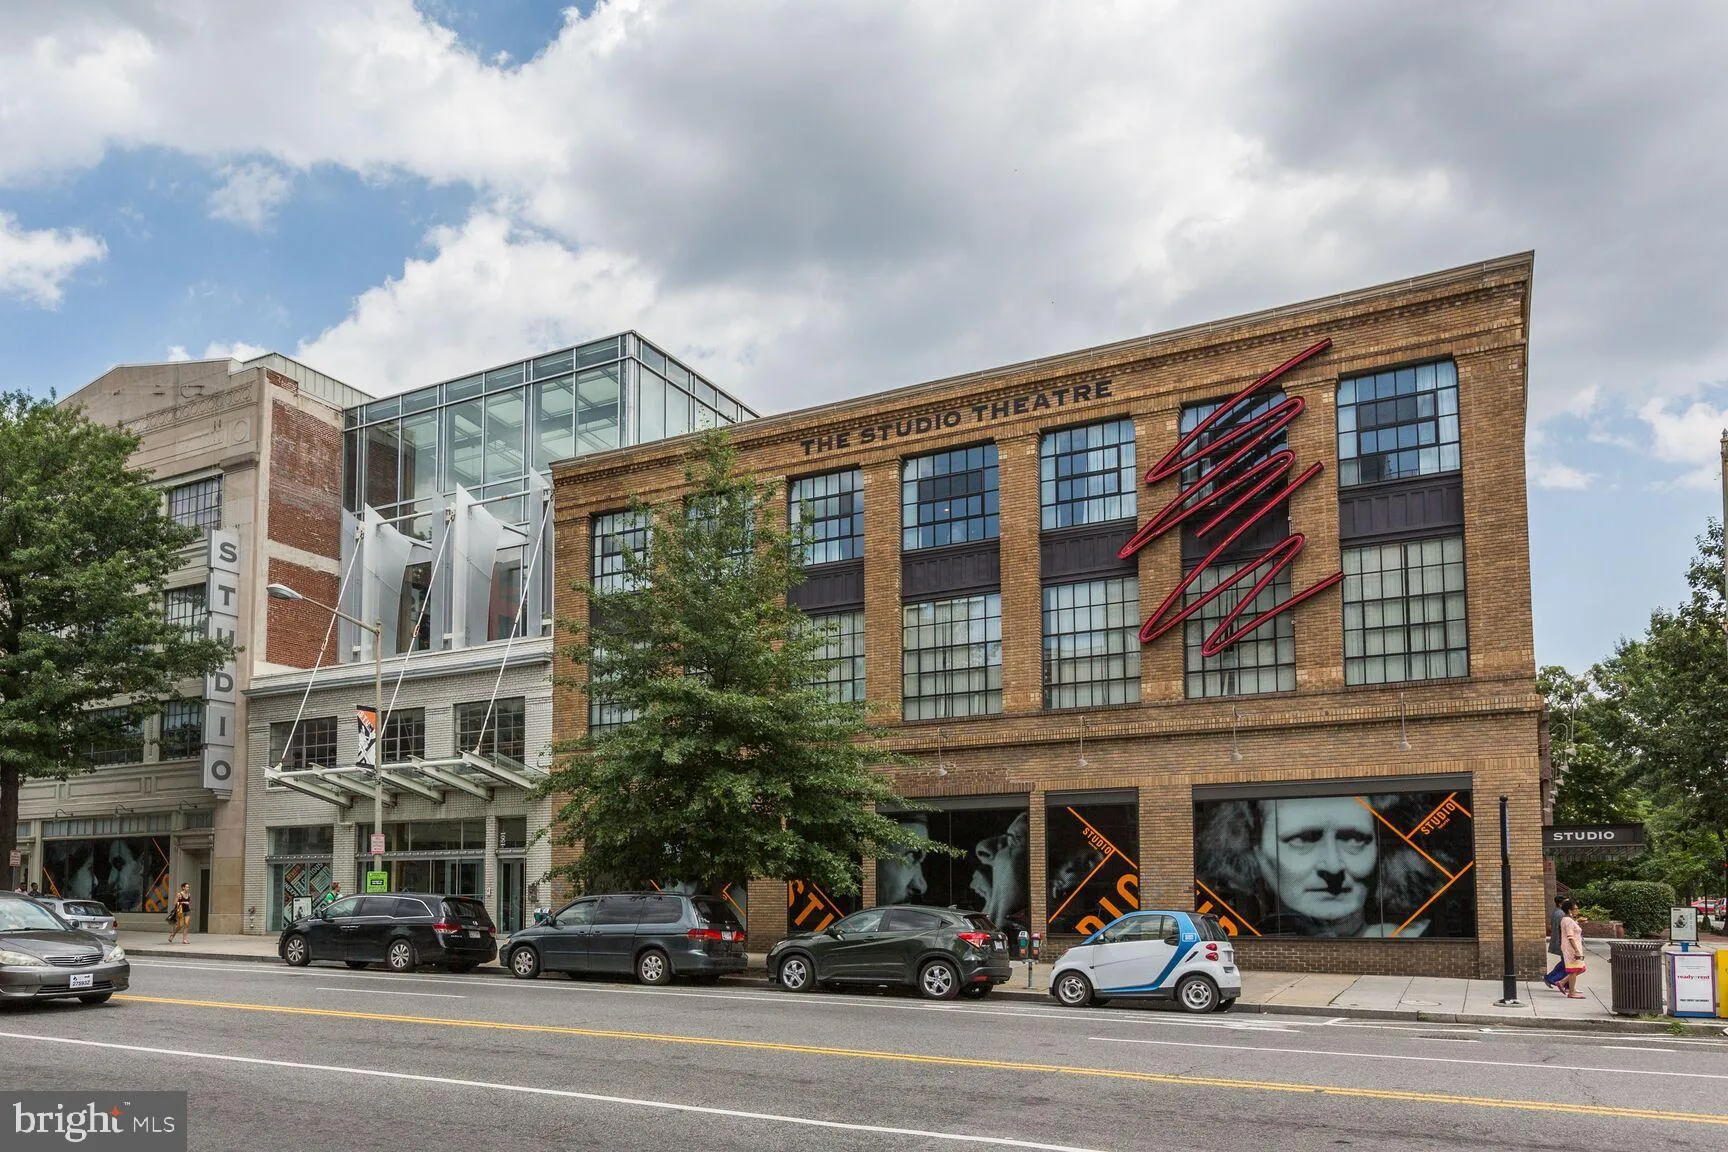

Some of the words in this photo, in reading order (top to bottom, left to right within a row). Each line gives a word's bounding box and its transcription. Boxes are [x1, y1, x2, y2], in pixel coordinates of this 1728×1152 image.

[801, 434, 849, 456] THE
[860, 410, 961, 445] STUDIO
[972, 379, 1113, 422] THEATRE
[1421, 802, 1456, 835] STUDIO
[1082, 826, 1113, 855] STUDIO
[1553, 831, 1615, 841] STUDIO
